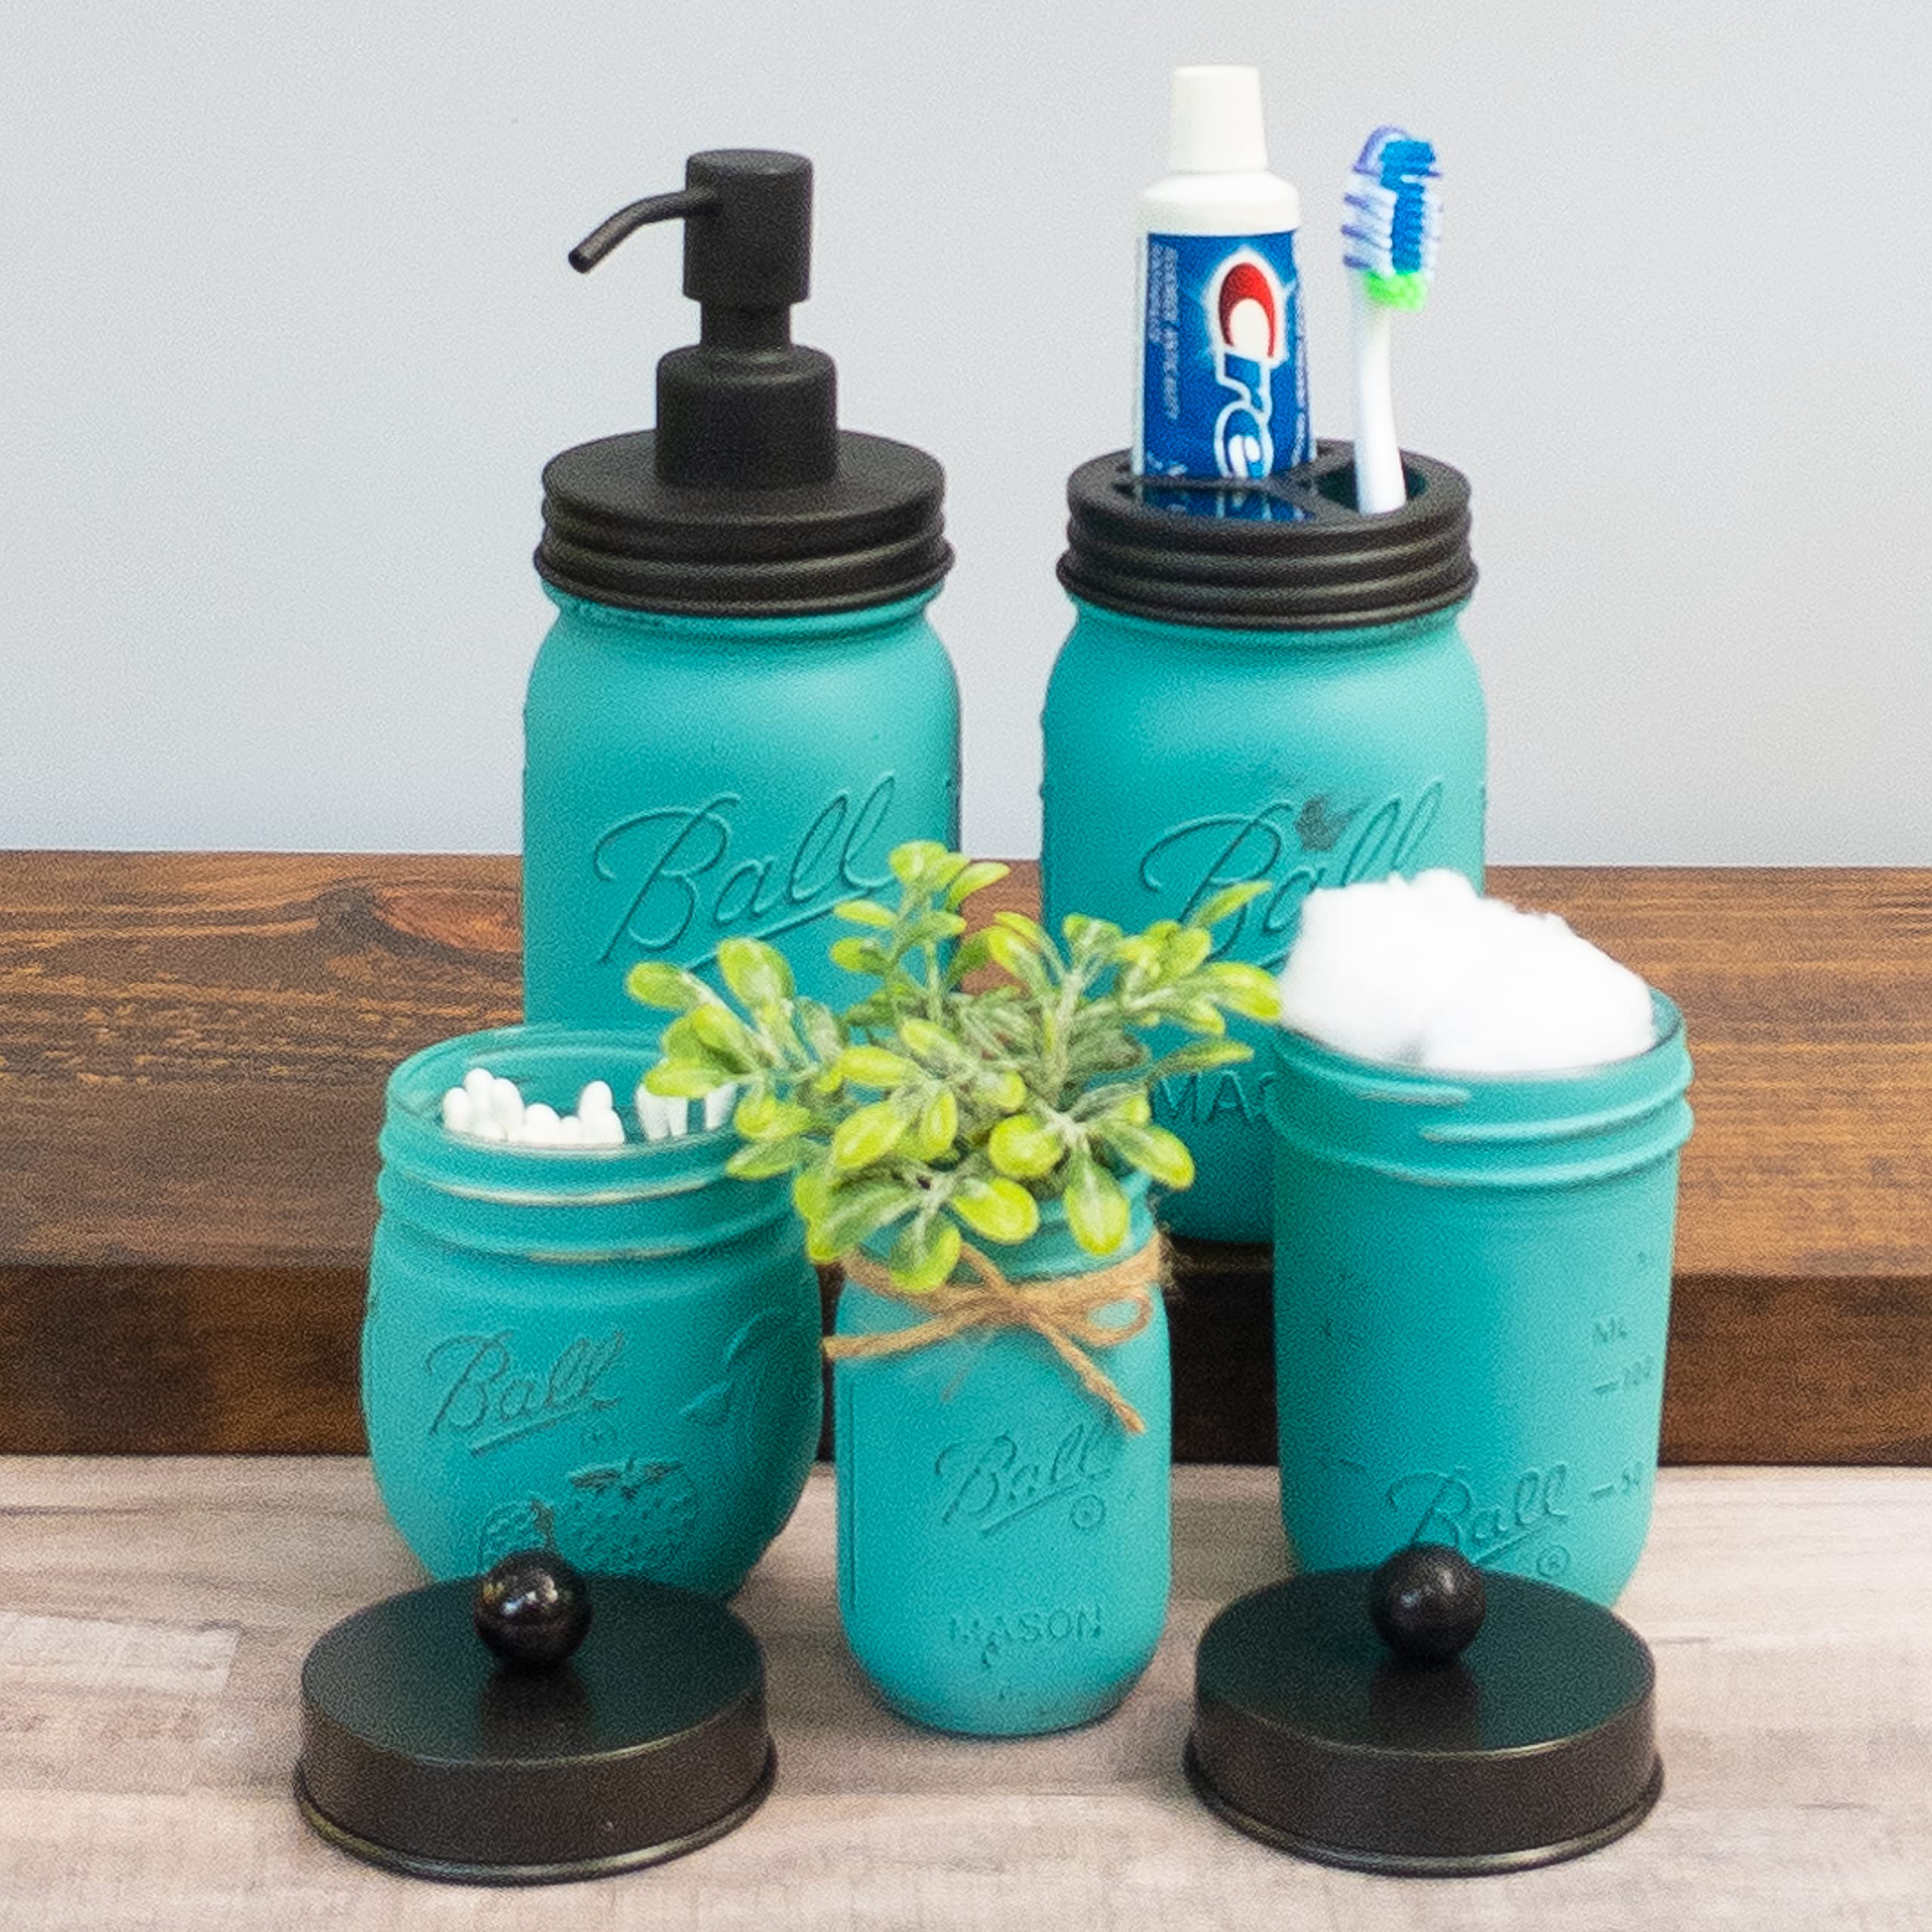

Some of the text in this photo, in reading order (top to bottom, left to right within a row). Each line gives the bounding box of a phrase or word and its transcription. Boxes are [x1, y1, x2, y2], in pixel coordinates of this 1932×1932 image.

[593, 770, 897, 964] Ball
[426, 1324, 626, 1437] Ball
[934, 1423, 1112, 1524] Ball
